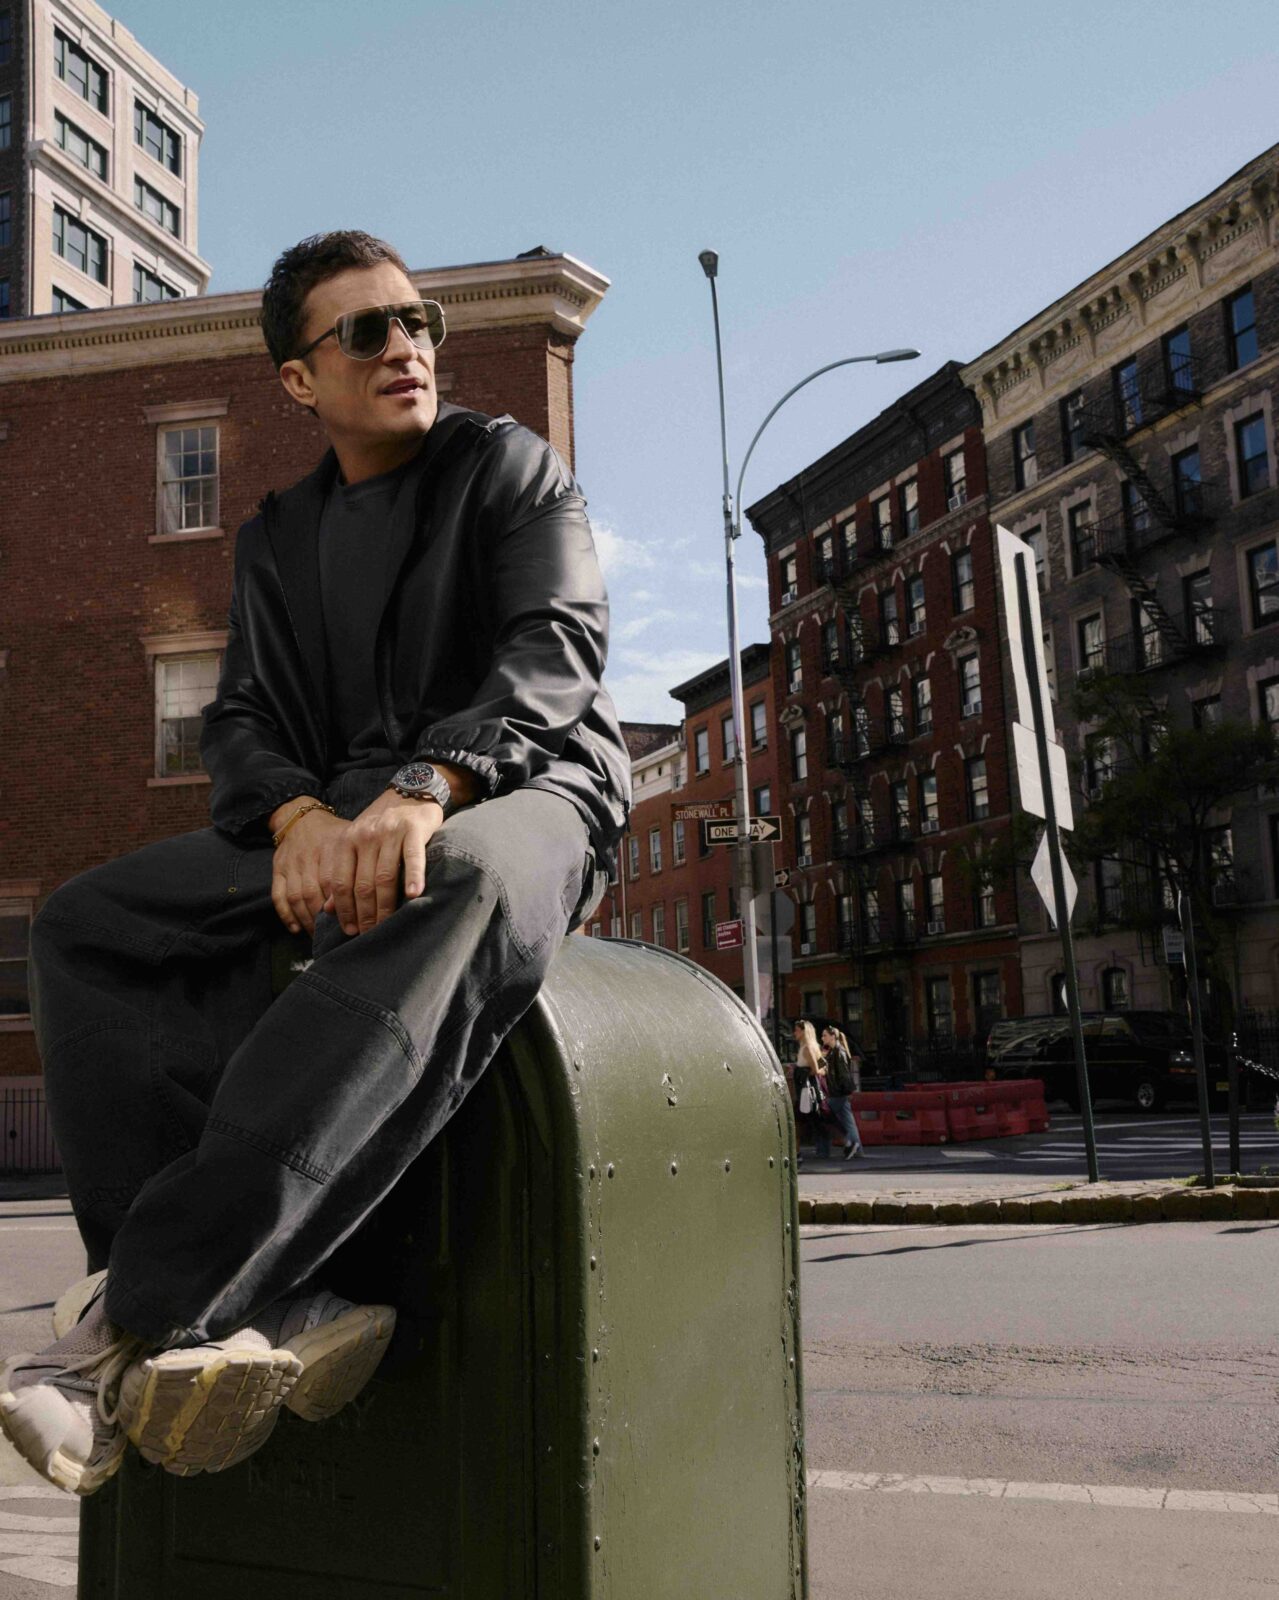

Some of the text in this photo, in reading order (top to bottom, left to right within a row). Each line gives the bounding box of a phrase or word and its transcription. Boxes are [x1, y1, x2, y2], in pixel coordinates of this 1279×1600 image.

[675, 808, 717, 820] STONEWALL
[720, 807, 730, 817] PL
[714, 827, 734, 837] ONE
